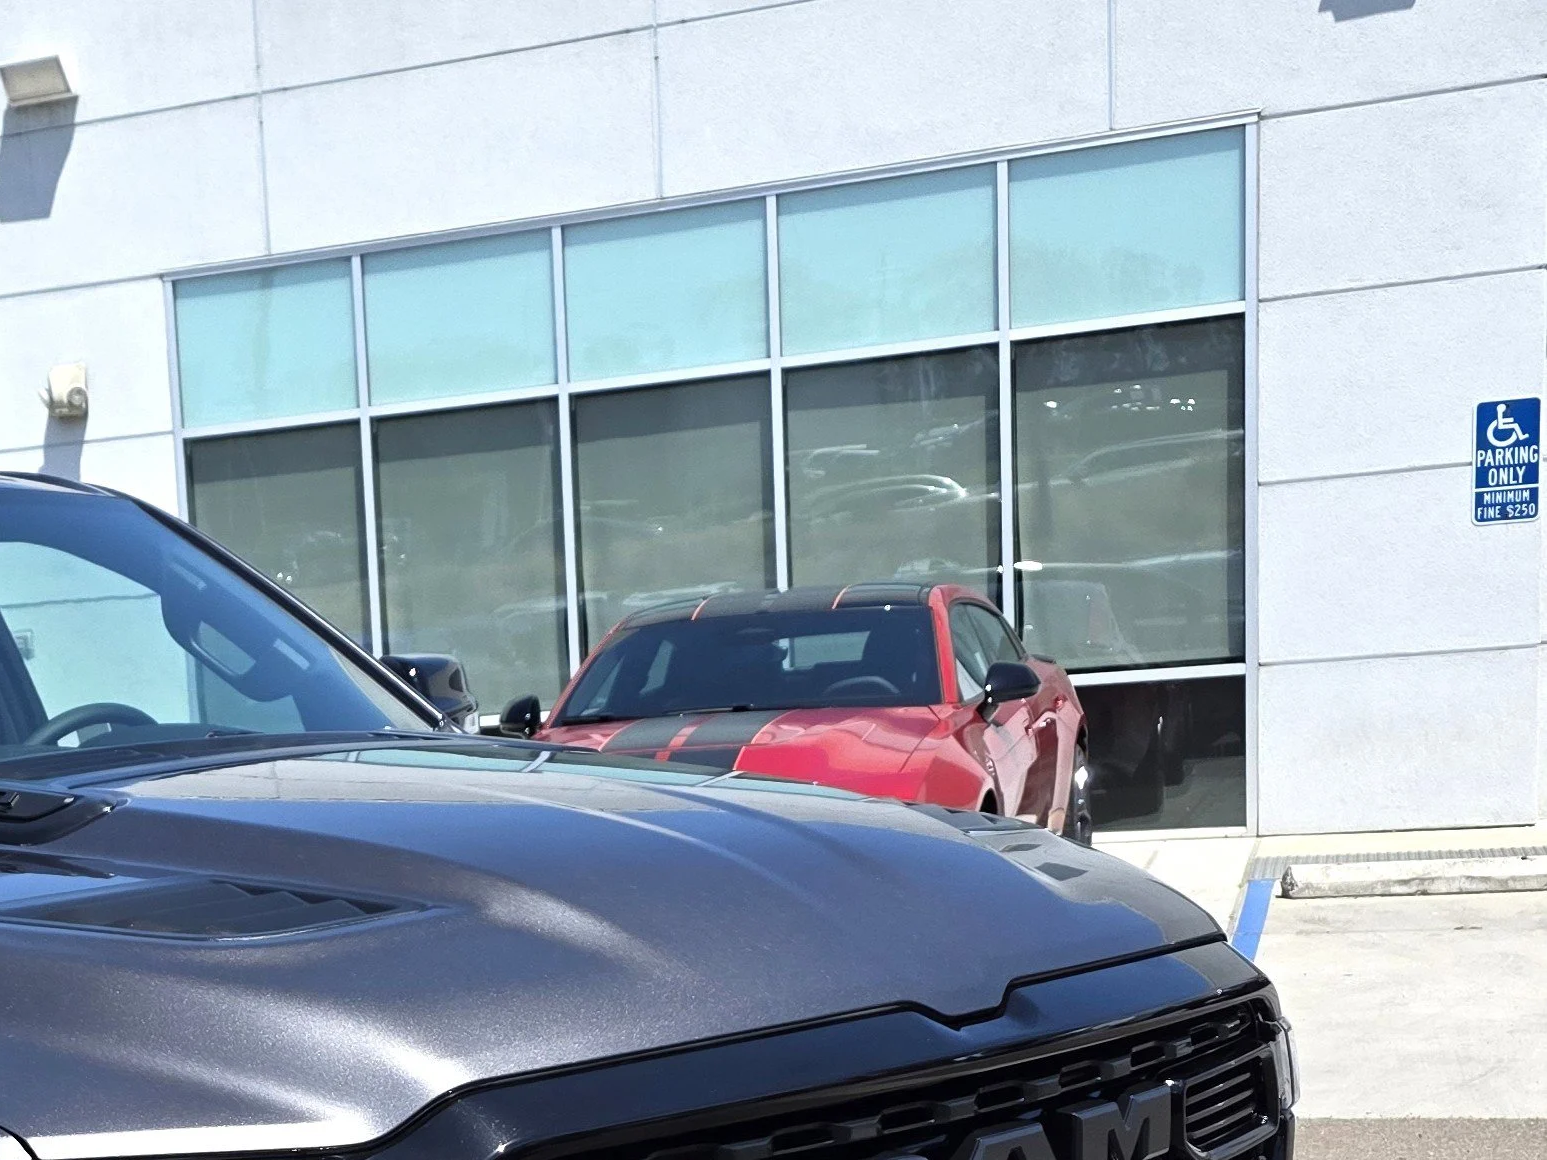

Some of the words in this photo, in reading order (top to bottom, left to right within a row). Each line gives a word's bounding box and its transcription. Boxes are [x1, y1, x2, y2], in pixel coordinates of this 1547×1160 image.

[1476, 445, 1539, 467] PARKING
[1488, 466, 1526, 486] ONLY
[1483, 489, 1531, 505] MINIMUM
[1477, 505, 1501, 519] FINE
[1506, 503, 1536, 518] $250
